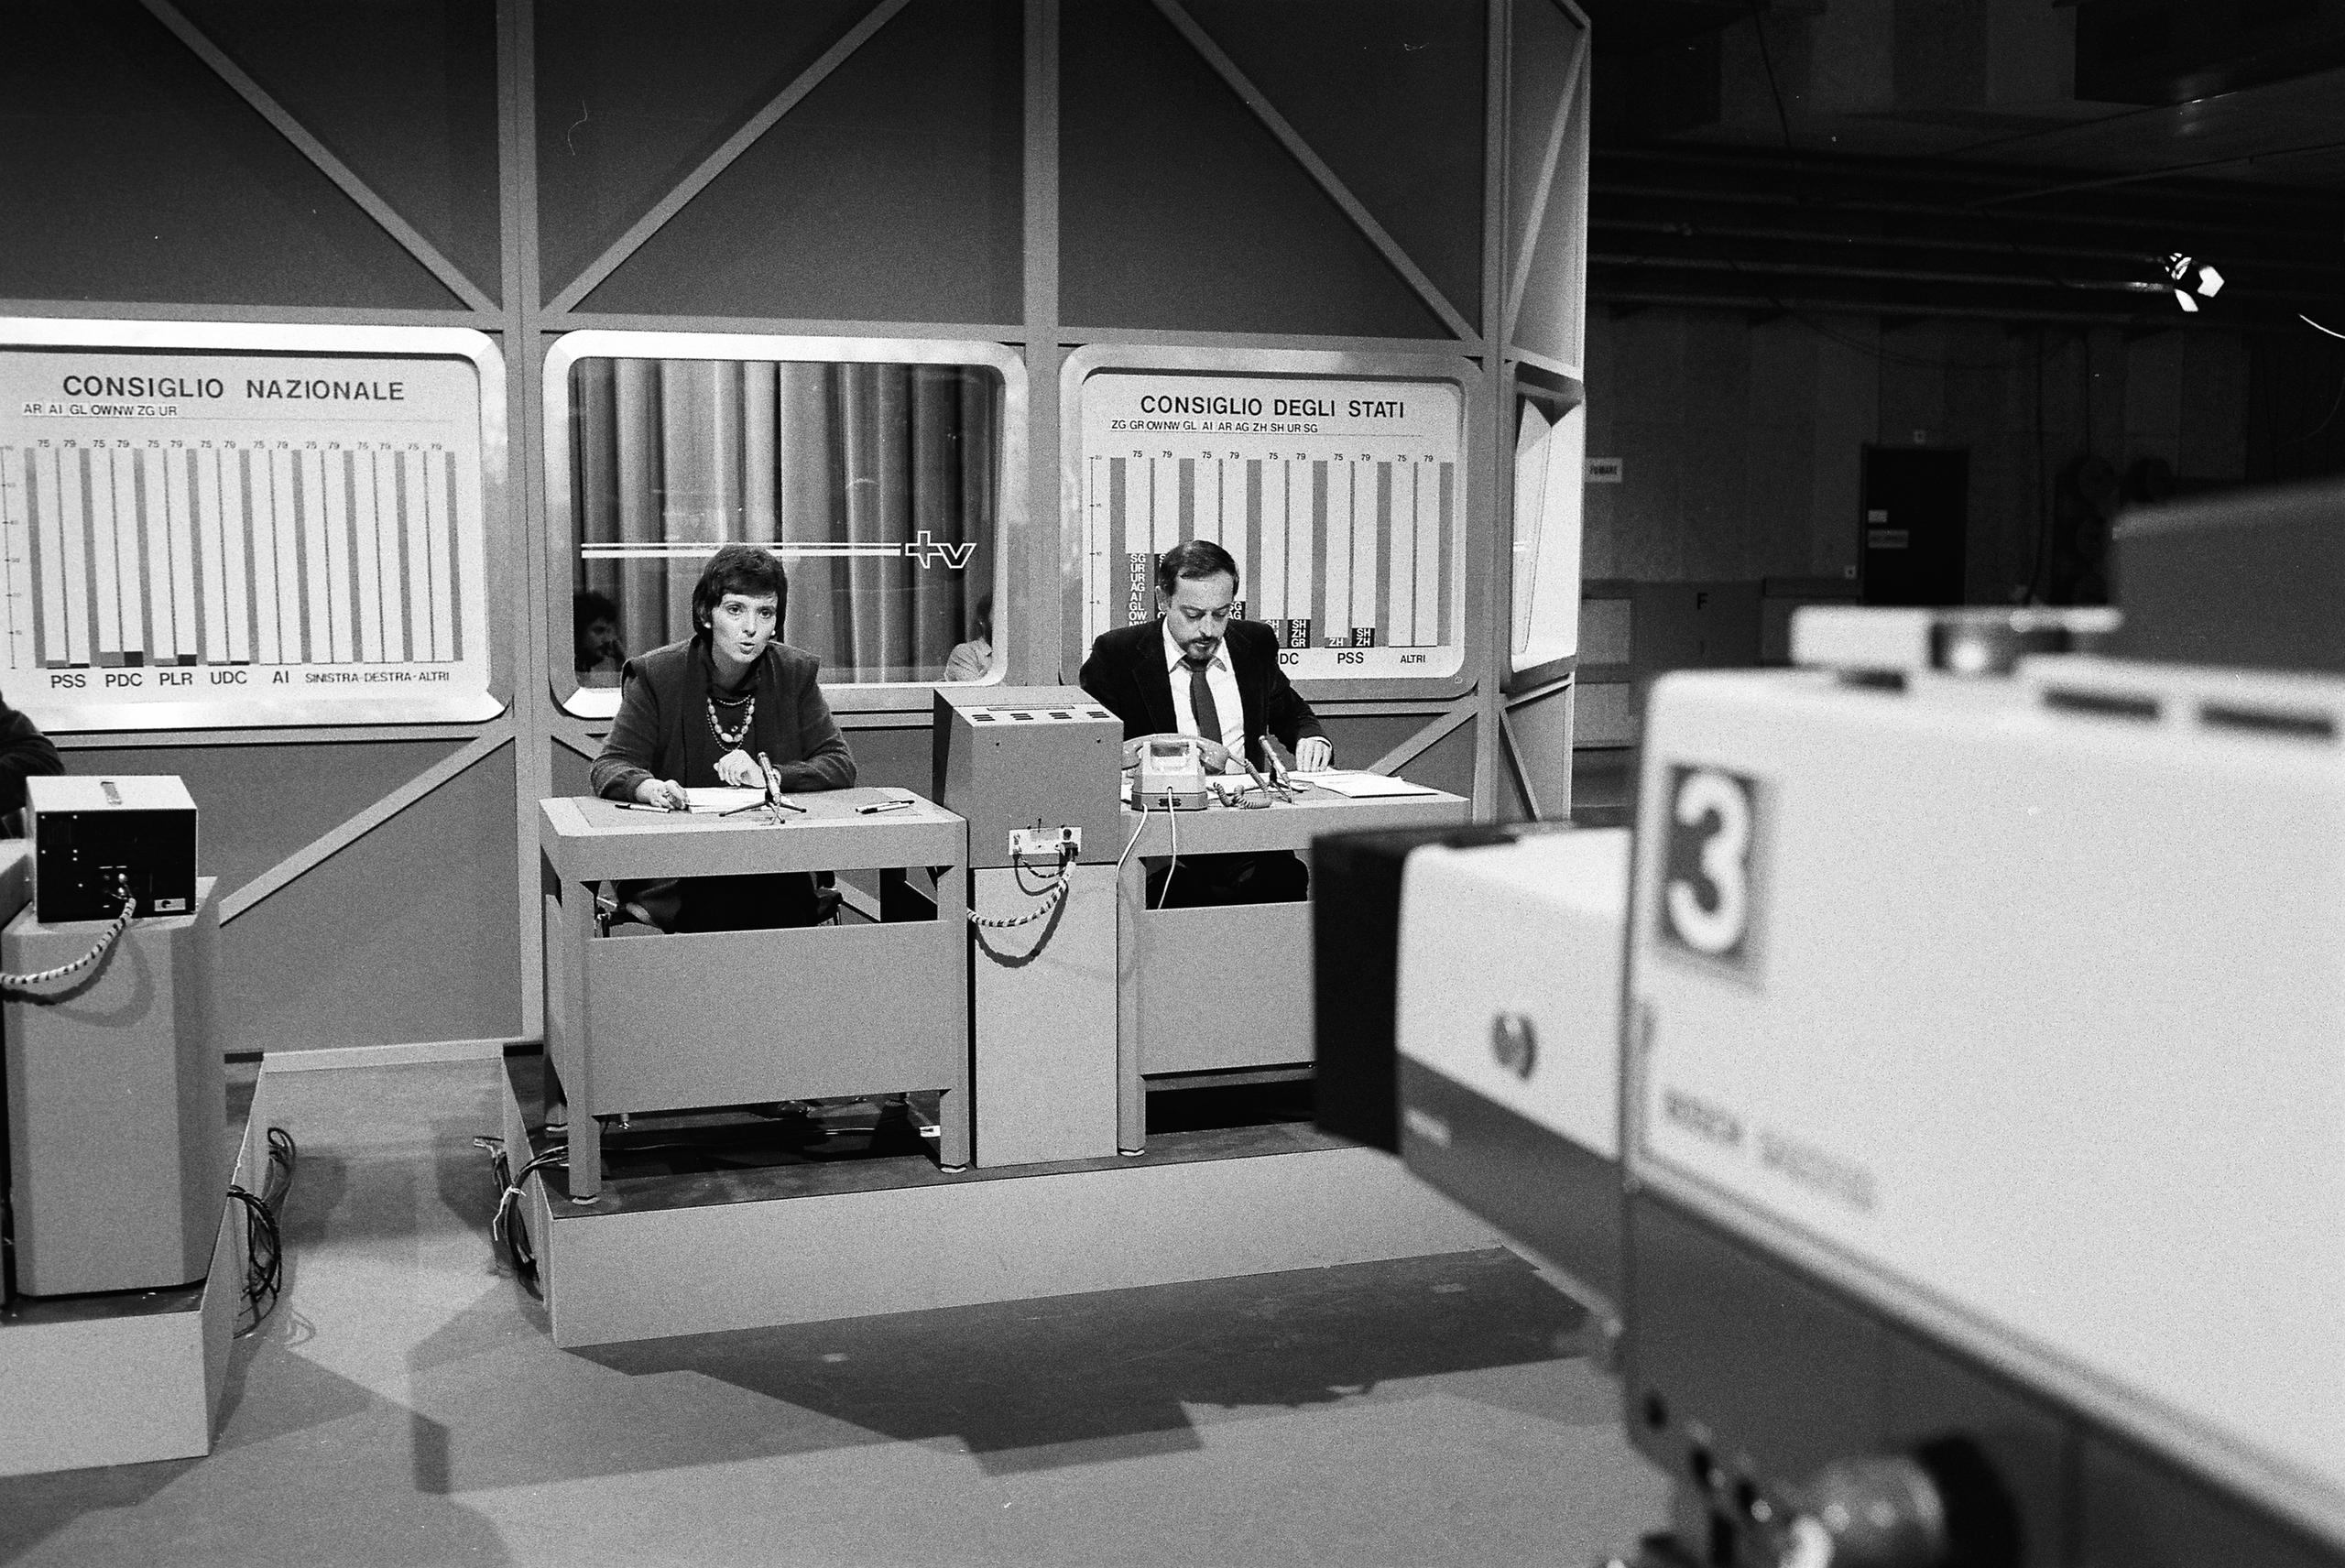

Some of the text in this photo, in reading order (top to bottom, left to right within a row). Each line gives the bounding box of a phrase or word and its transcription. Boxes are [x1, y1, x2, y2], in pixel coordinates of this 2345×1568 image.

[62, 375, 405, 401] CONSIGLIO NAZIONALE
[24, 403, 42, 414] AR
[69, 405, 88, 416] GL
[136, 406, 156, 417] ZG
[158, 406, 177, 417] UR
[1140, 395, 1404, 419] CONSIGLIO DEGLI STATI
[1111, 419, 1127, 430] ZG
[1129, 419, 1145, 430] GR
[1183, 420, 1197, 430] GL
[1217, 422, 1233, 431] AR
[1235, 422, 1249, 432] AG
[1252, 423, 1268, 432] ZH
[1271, 423, 1284, 433] SH
[1287, 424, 1302, 433] UR
[1303, 424, 1318, 433] SG
[38, 440, 49, 448] 75
[63, 440, 76, 448] 79
[93, 440, 105, 448] 75
[117, 440, 129, 448] 79
[147, 440, 160, 449] 75
[170, 440, 182, 449] 79
[201, 440, 213, 449] 75
[224, 440, 236, 449] 79
[1133, 450, 1142, 458] 75
[1162, 450, 1172, 458] 79
[1202, 451, 1212, 459] 75
[1229, 452, 1239, 460] 79
[1296, 452, 1306, 461] 79
[1397, 454, 1407, 463] 75
[1423, 454, 1434, 463] 79
[1130, 553, 1146, 562] SG
[1130, 563, 1145, 572] UR
[1130, 573, 1145, 582] UR
[1130, 583, 1145, 592] AG
[1130, 593, 1141, 601] AI
[1129, 602, 1144, 611] GL
[1129, 611, 1147, 620] OW
[1292, 619, 1306, 628] SH
[1292, 629, 1305, 637] ZH
[1356, 628, 1370, 637] SH
[1291, 638, 1305, 647] GR
[1329, 638, 1343, 647] ZH
[1356, 637, 1370, 646] ZH
[1279, 652, 1426, 664] DC PSS ALTRI
[50, 674, 86, 687] PSS
[105, 673, 143, 687] PDC
[159, 672, 192, 685] PLR
[210, 670, 247, 684] UDC
[272, 670, 289, 683] AI
[1667, 772, 1747, 953] 3
